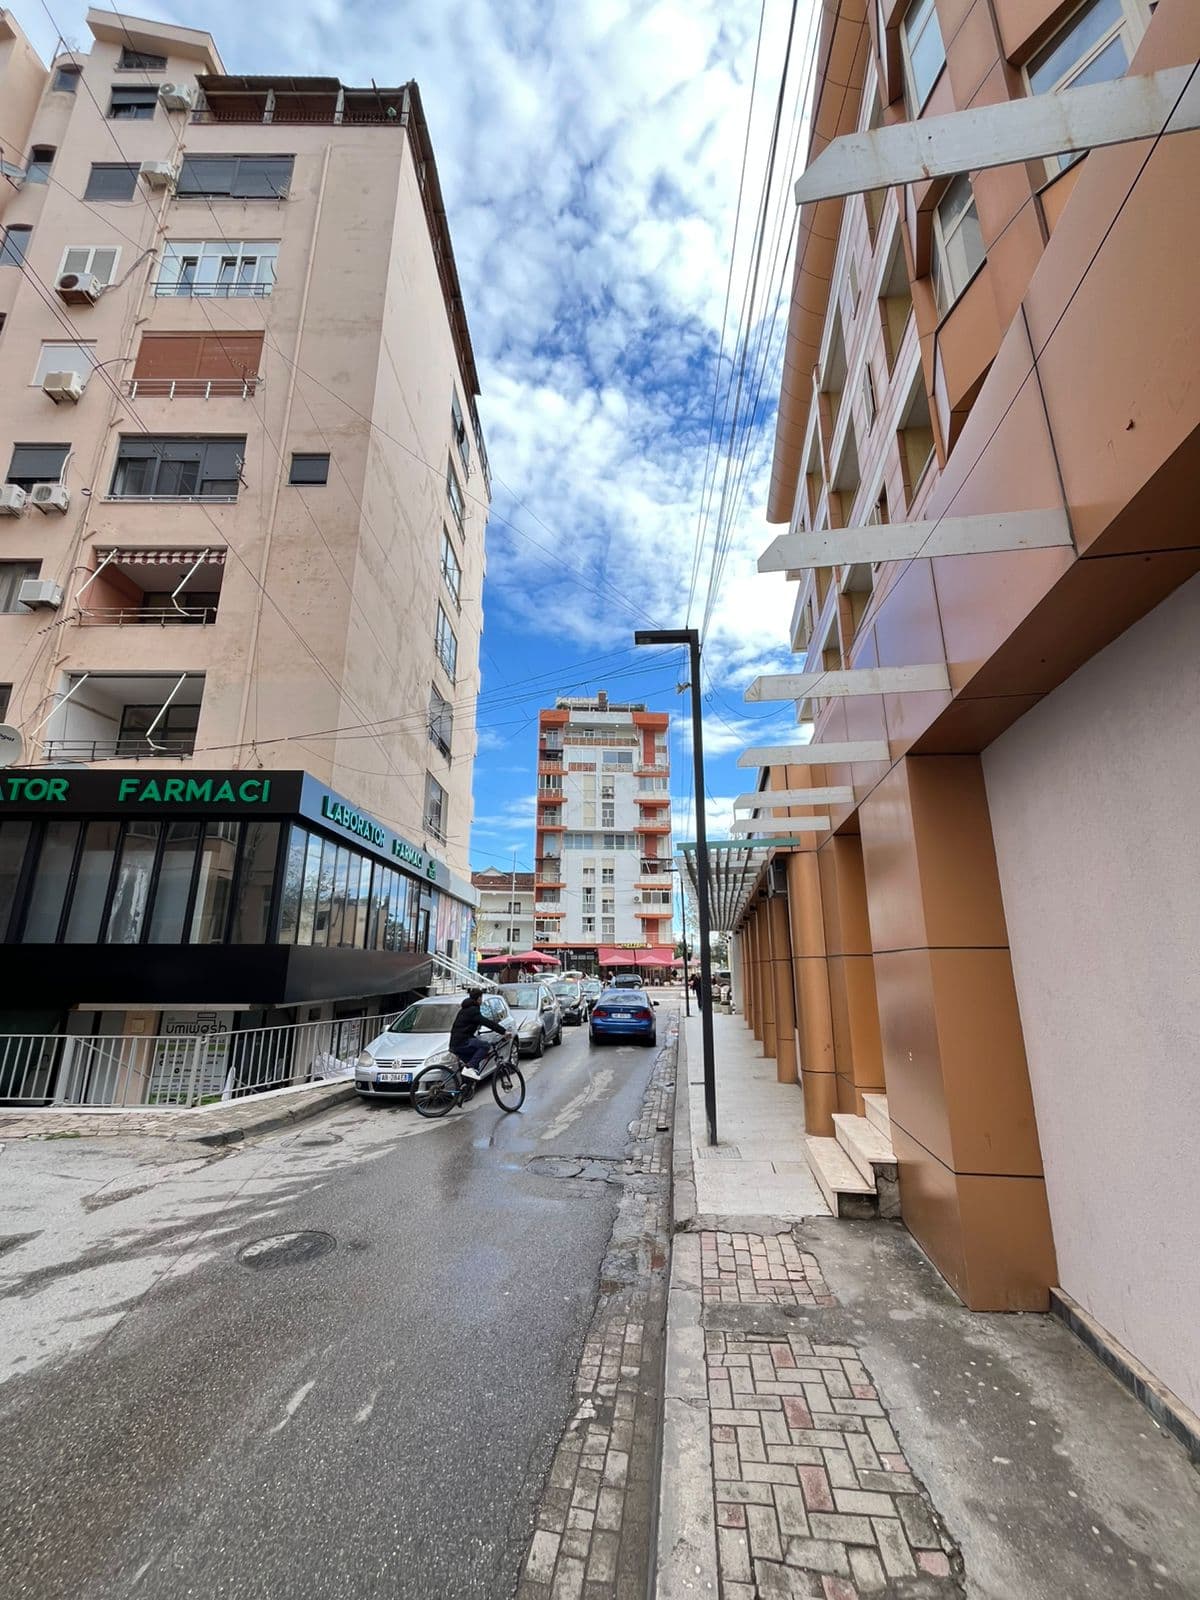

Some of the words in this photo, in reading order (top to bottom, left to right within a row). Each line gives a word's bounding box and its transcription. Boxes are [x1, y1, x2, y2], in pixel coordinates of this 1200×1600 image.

[0, 777, 69, 801] TOR
[118, 778, 271, 802] FARMACI
[321, 795, 385, 848] LABORATOR
